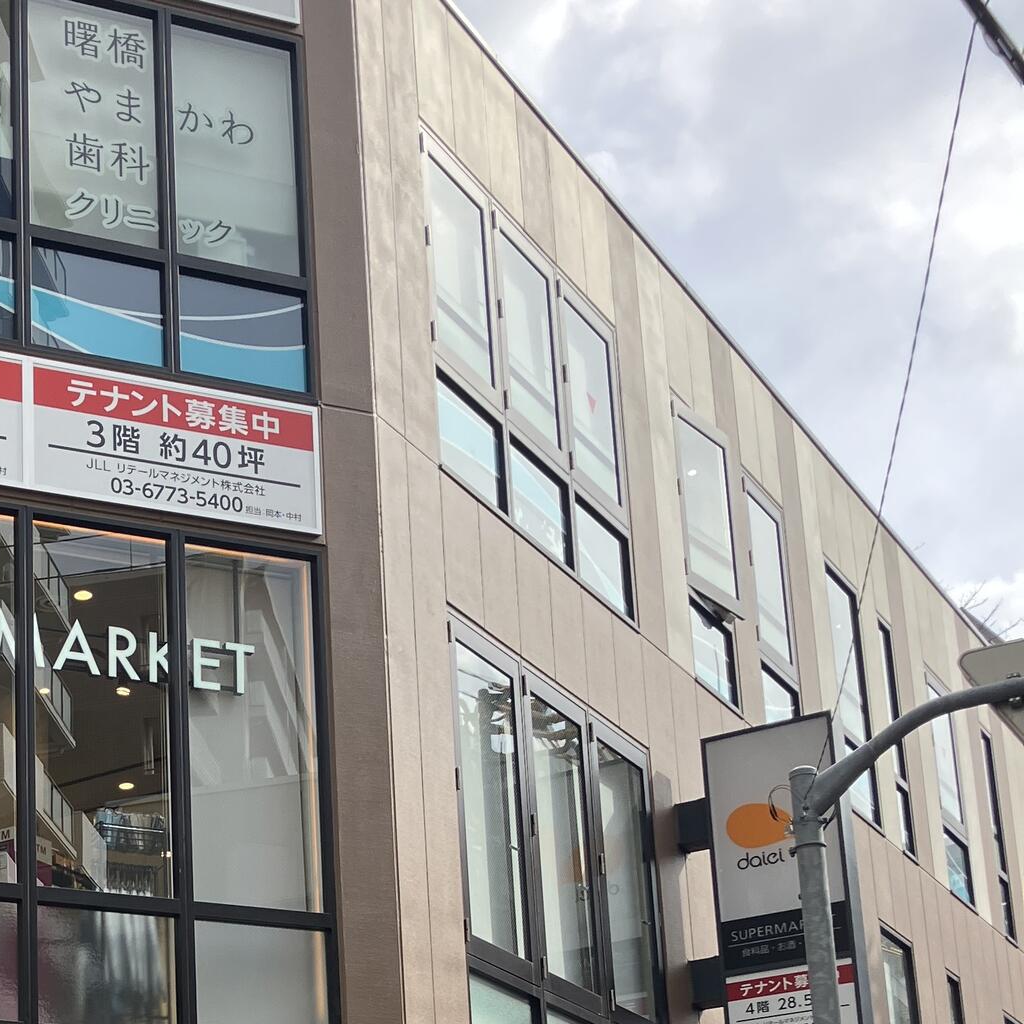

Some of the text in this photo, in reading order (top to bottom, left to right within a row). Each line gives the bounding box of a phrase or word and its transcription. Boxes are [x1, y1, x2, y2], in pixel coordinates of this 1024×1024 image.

[64, 18, 148, 70] 曙橋
[65, 133, 151, 182] 歯科
[67, 379, 280, 440] テナント募集中
[86, 420, 265, 474] 3階 約40坪
[86, 457, 265, 497] JLL リテールマネジメント株式会社
[111, 477, 243, 513] 03-6773-5400
[737, 849, 785, 870] daiei
[739, 974, 810, 996] テナント募
[745, 1000, 770, 1015] 4階
